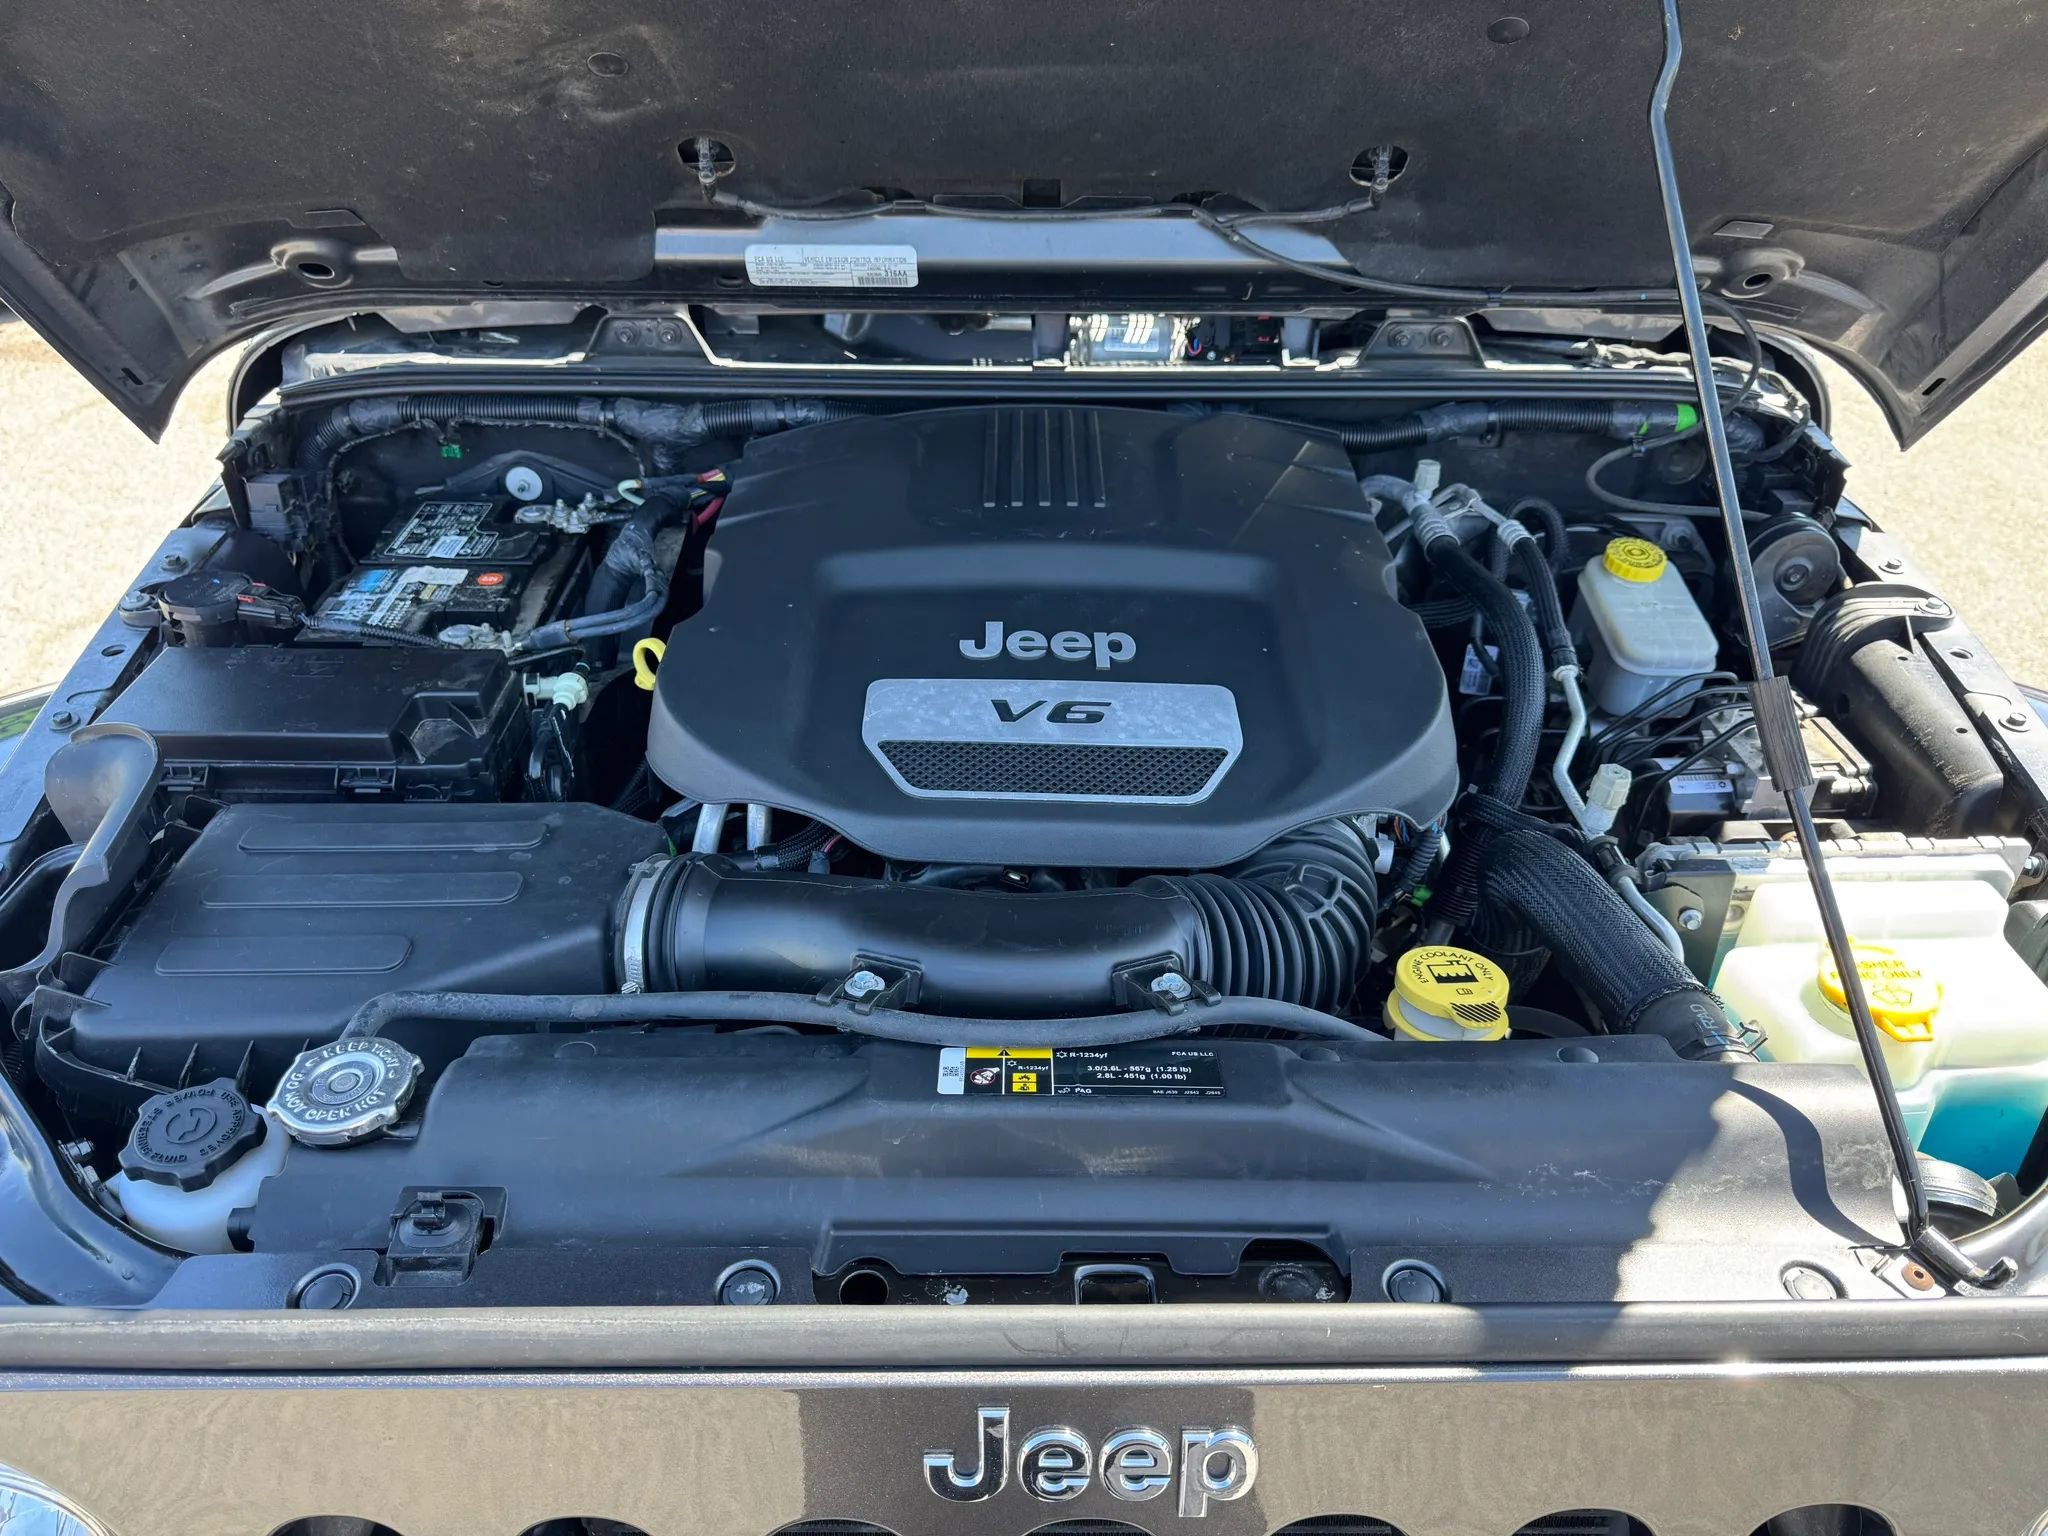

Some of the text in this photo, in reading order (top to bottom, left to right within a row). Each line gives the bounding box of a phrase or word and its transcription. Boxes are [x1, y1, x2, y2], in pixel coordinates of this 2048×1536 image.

[959, 621, 1137, 670] Jeep
[990, 698, 1112, 724] V6
[1411, 951, 1494, 984] ENGINE COOLANT ONLY
[321, 1041, 369, 1059] KEEP
[1123, 1072, 1146, 1080] 451g
[1174, 1073, 1187, 1081] lb)
[1129, 1065, 1151, 1073] 567g
[1179, 1066, 1192, 1074] lb)
[305, 1109, 352, 1121] OPEN
[355, 1087, 387, 1112] HOT
[923, 1404, 1260, 1519] Jeep
